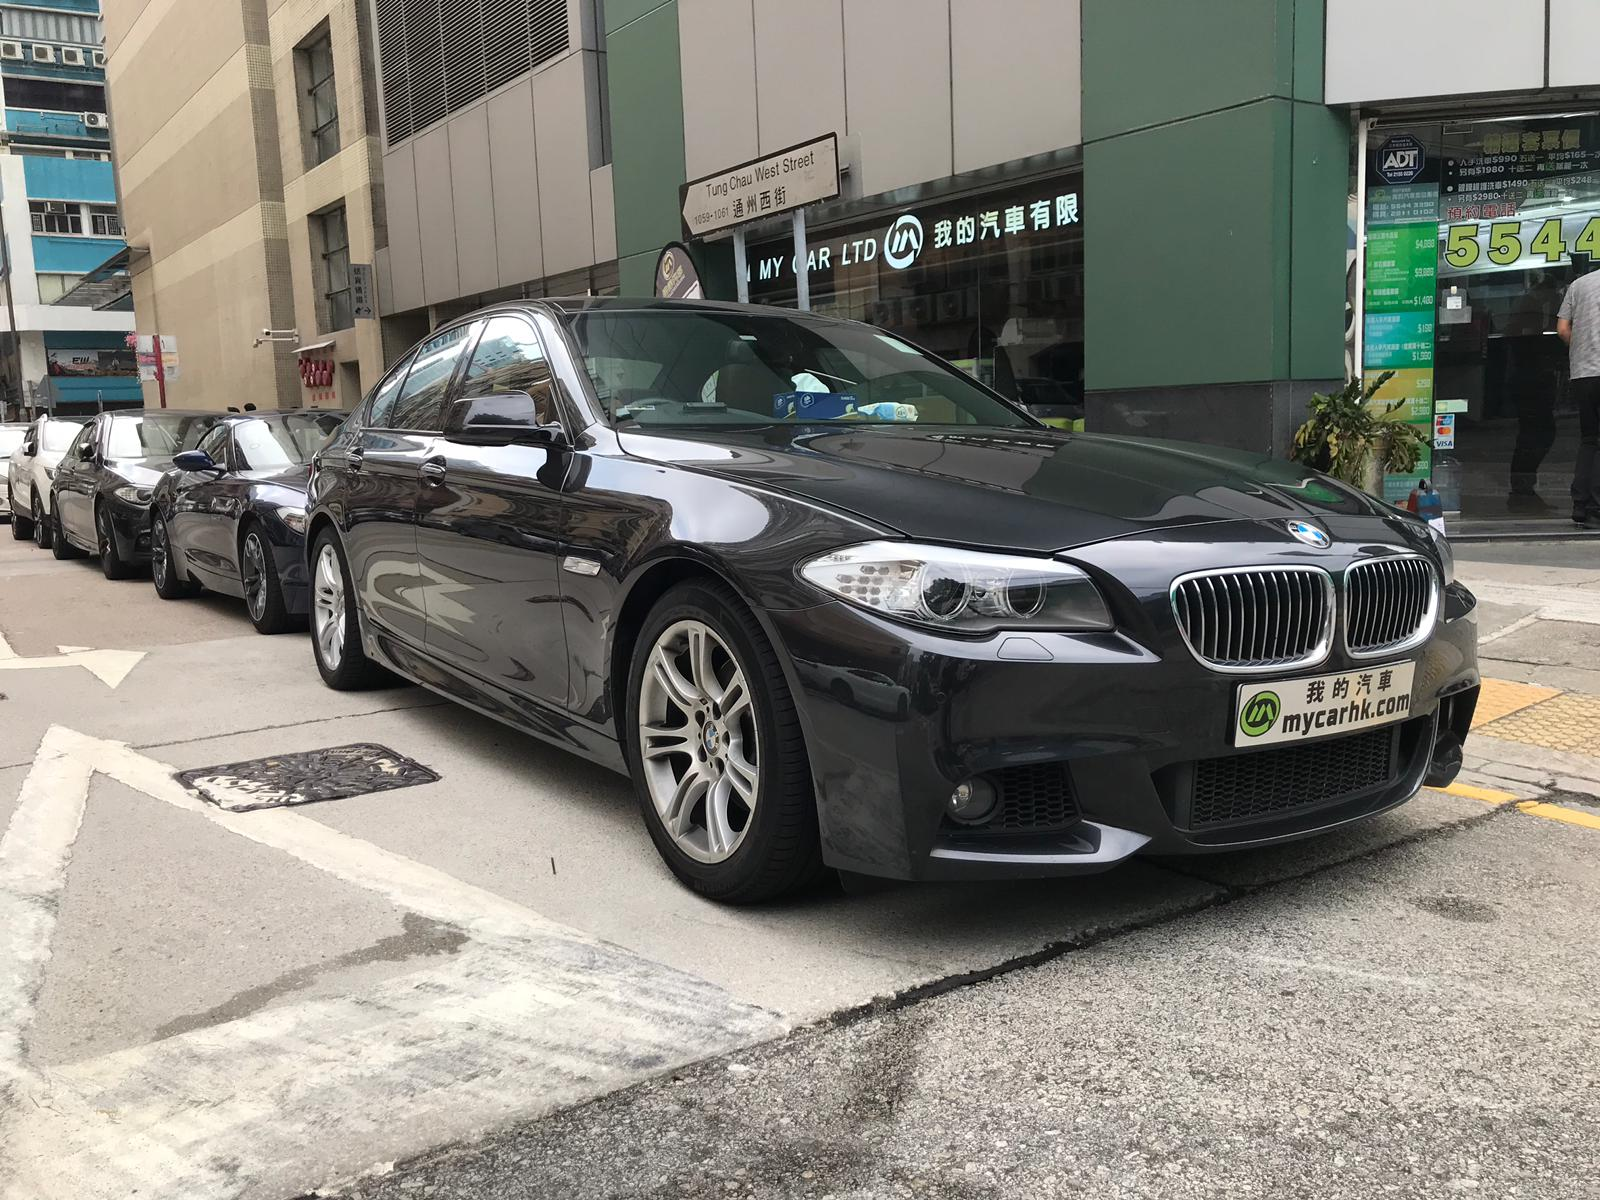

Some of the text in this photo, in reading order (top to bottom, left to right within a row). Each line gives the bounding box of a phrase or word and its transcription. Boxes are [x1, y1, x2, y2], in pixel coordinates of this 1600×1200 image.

[706, 151, 815, 198] Tung Chau West Street
[1383, 150, 1418, 169] ADT
[732, 186, 786, 219] 通州西街
[934, 193, 1079, 249] 我的汽車有限
[759, 238, 877, 280] MY AR LTD
[1306, 669, 1393, 704] 我的汽車
[1282, 693, 1410, 735] mycarhk.com
